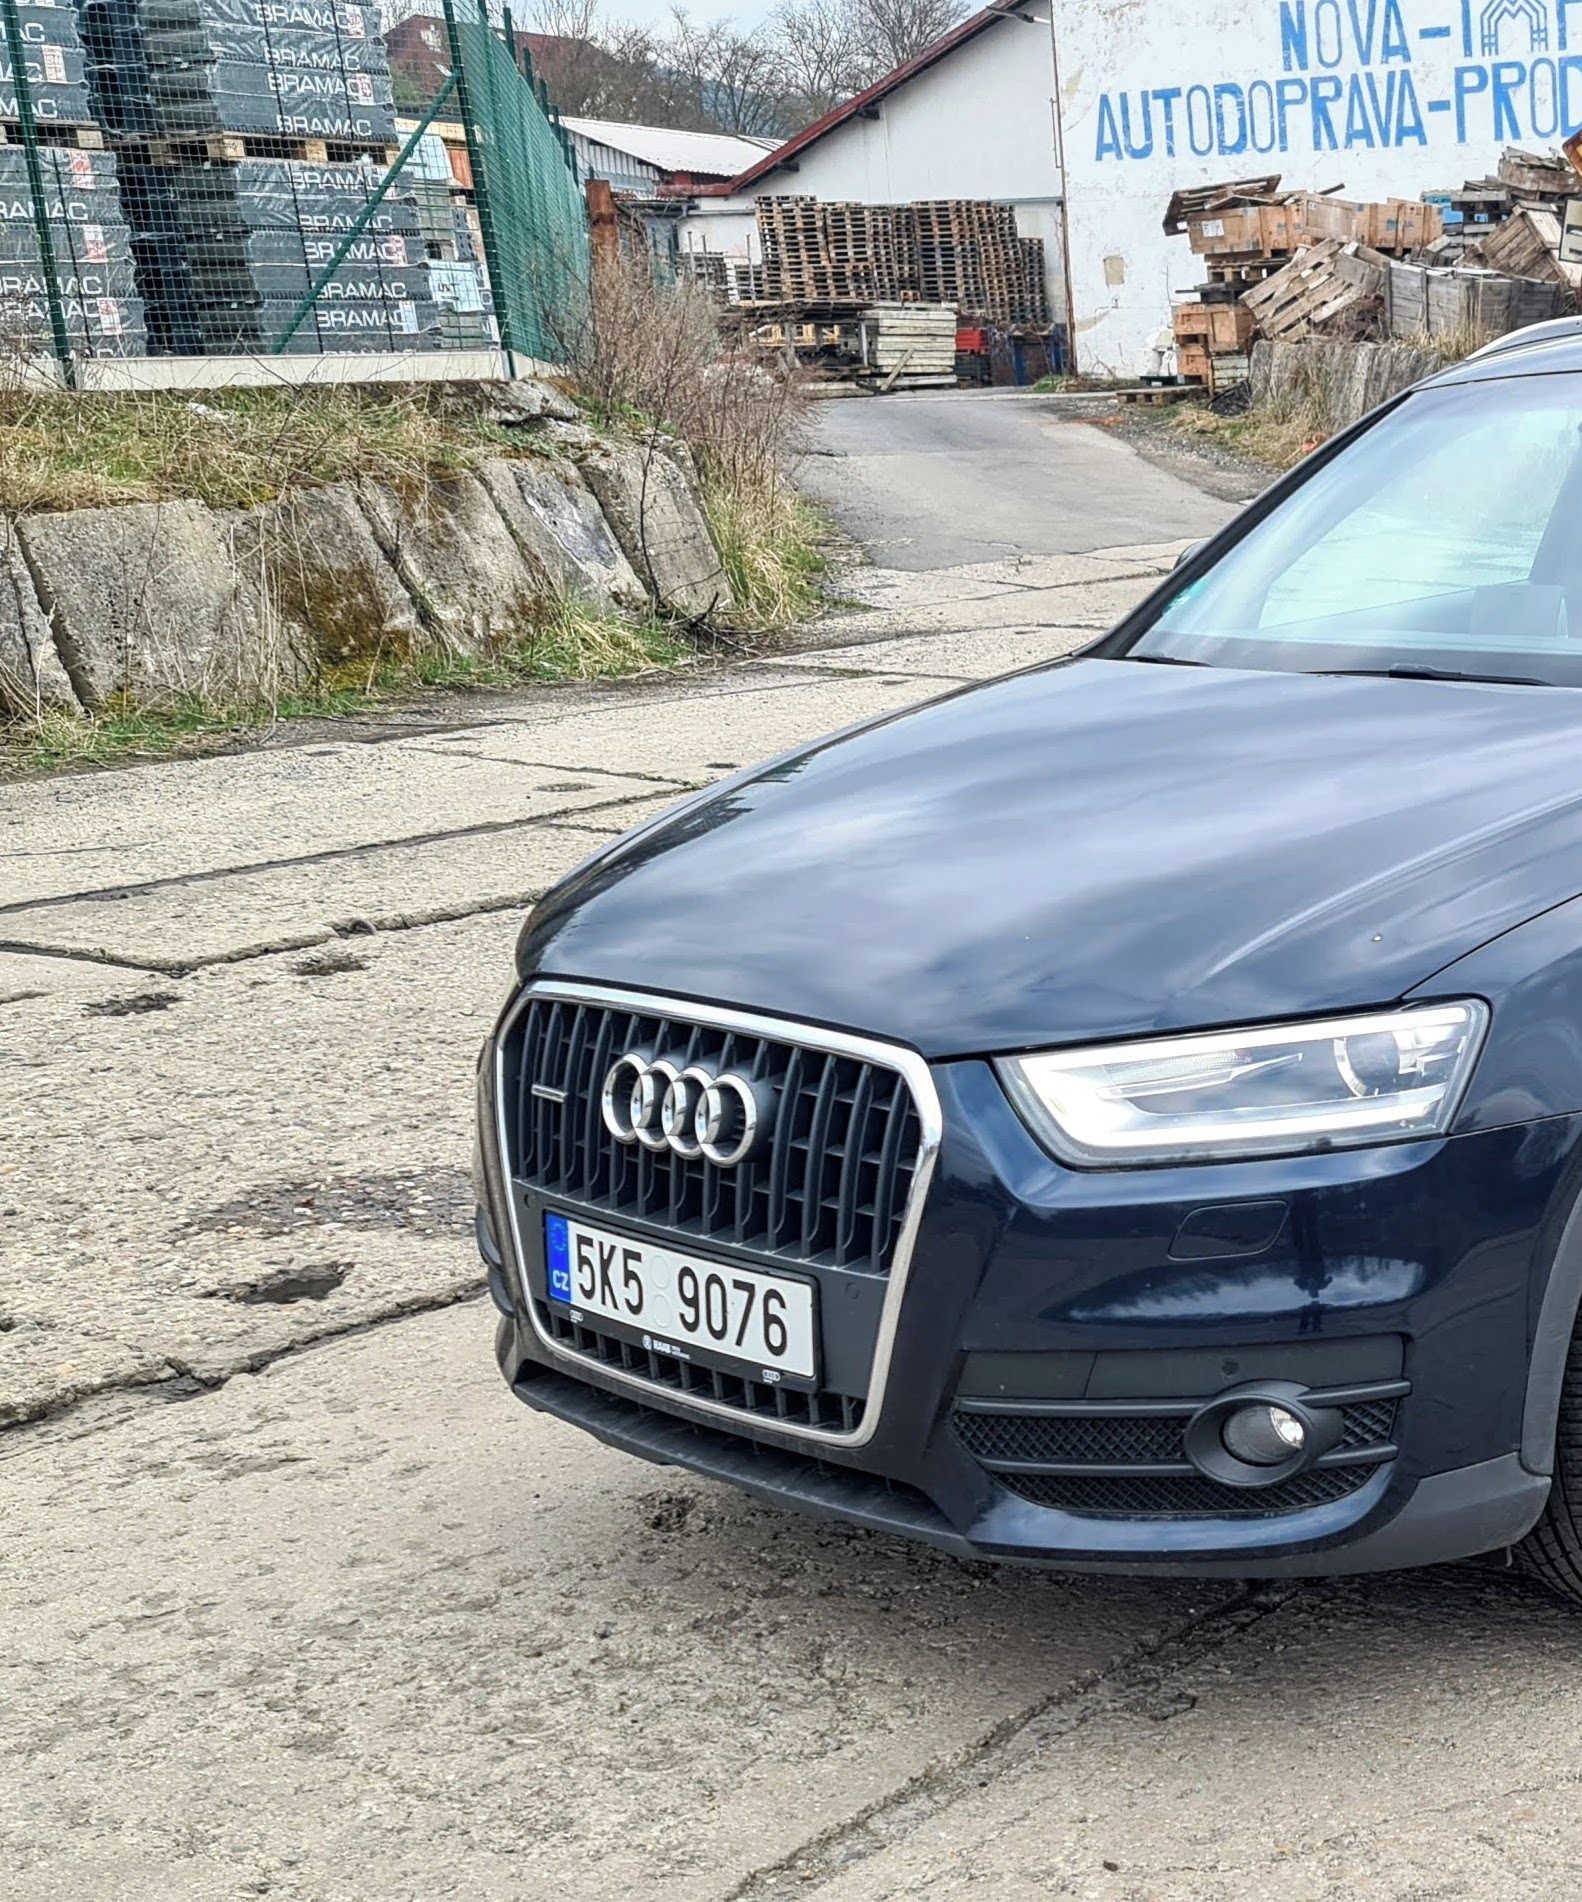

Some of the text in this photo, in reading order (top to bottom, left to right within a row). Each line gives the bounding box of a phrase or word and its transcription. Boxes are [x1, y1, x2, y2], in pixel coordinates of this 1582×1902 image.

[265, 47, 360, 71] BRAMAC
[268, 72, 360, 97] BRAMAC
[277, 115, 372, 137] BRAMAC
[552, 1269, 569, 1292] CZ
[576, 1233, 788, 1357] 5K5 9076
